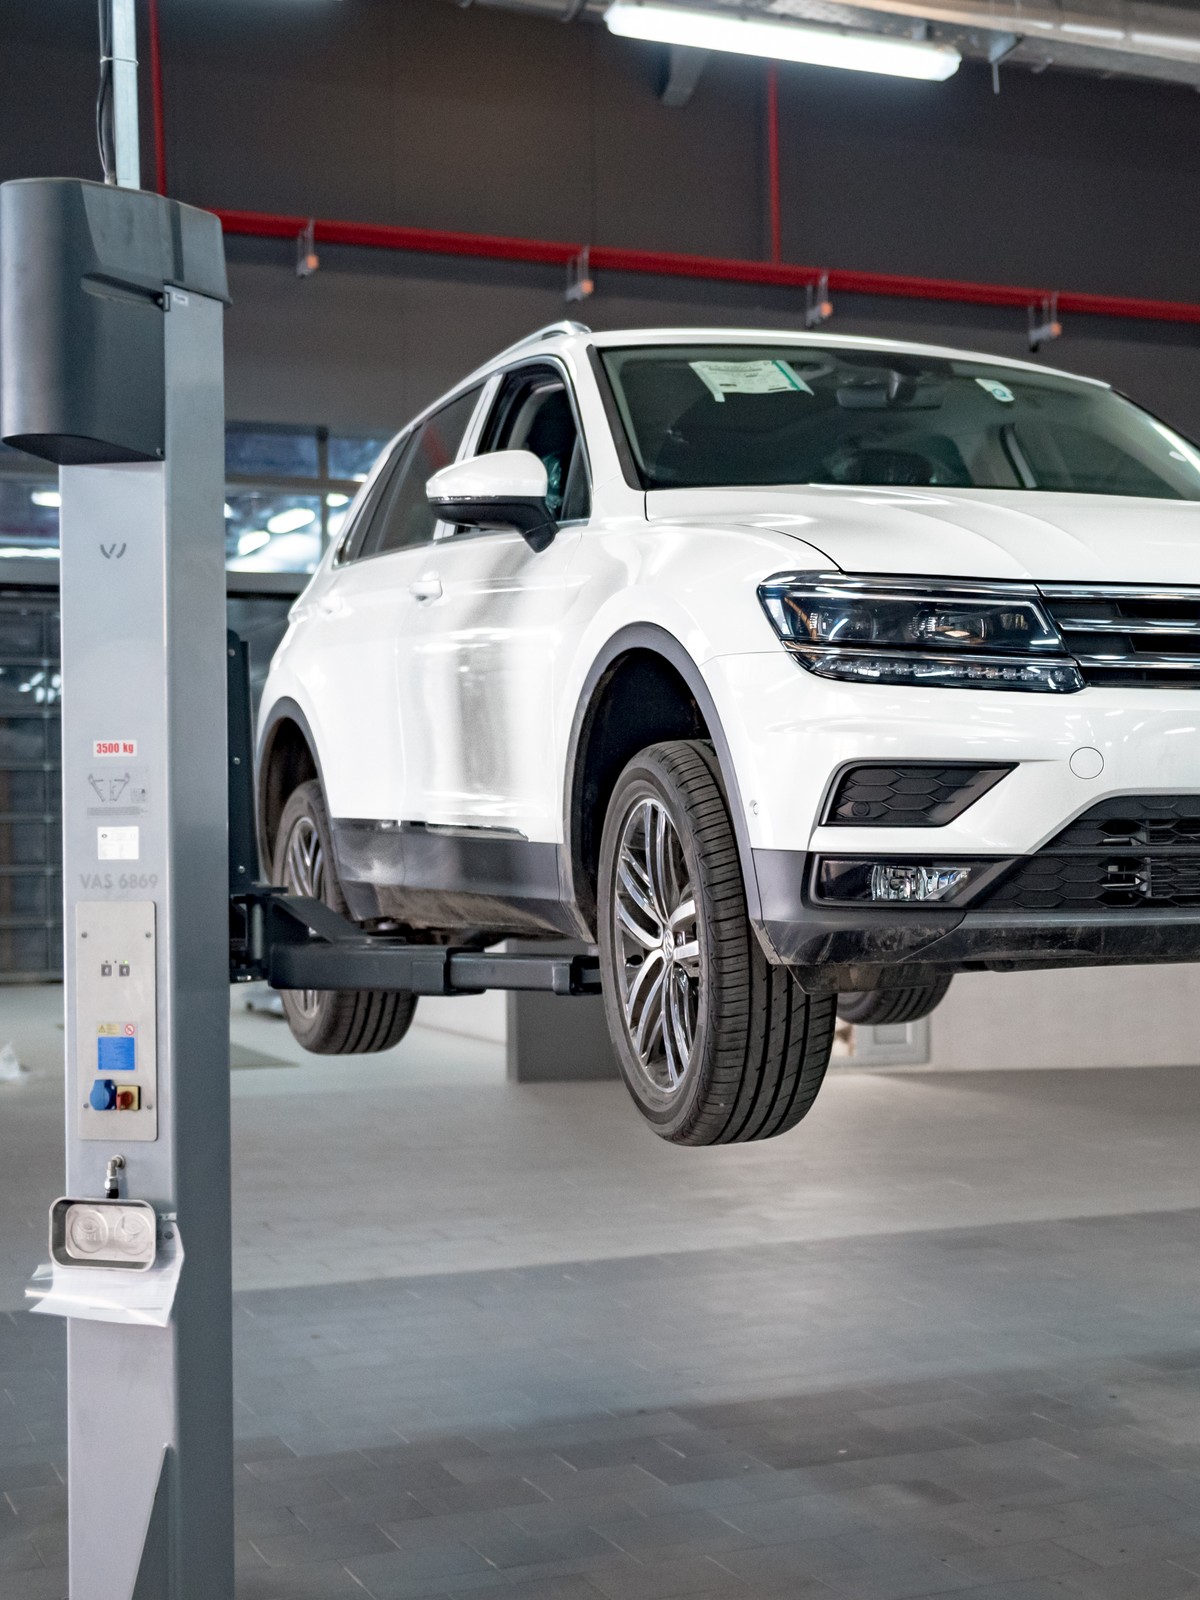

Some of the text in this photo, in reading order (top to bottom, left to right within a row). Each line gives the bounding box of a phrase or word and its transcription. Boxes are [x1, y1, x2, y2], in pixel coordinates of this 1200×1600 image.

[96, 743, 134, 754] 3500 kg
[80, 873, 158, 889] VAS 6869
